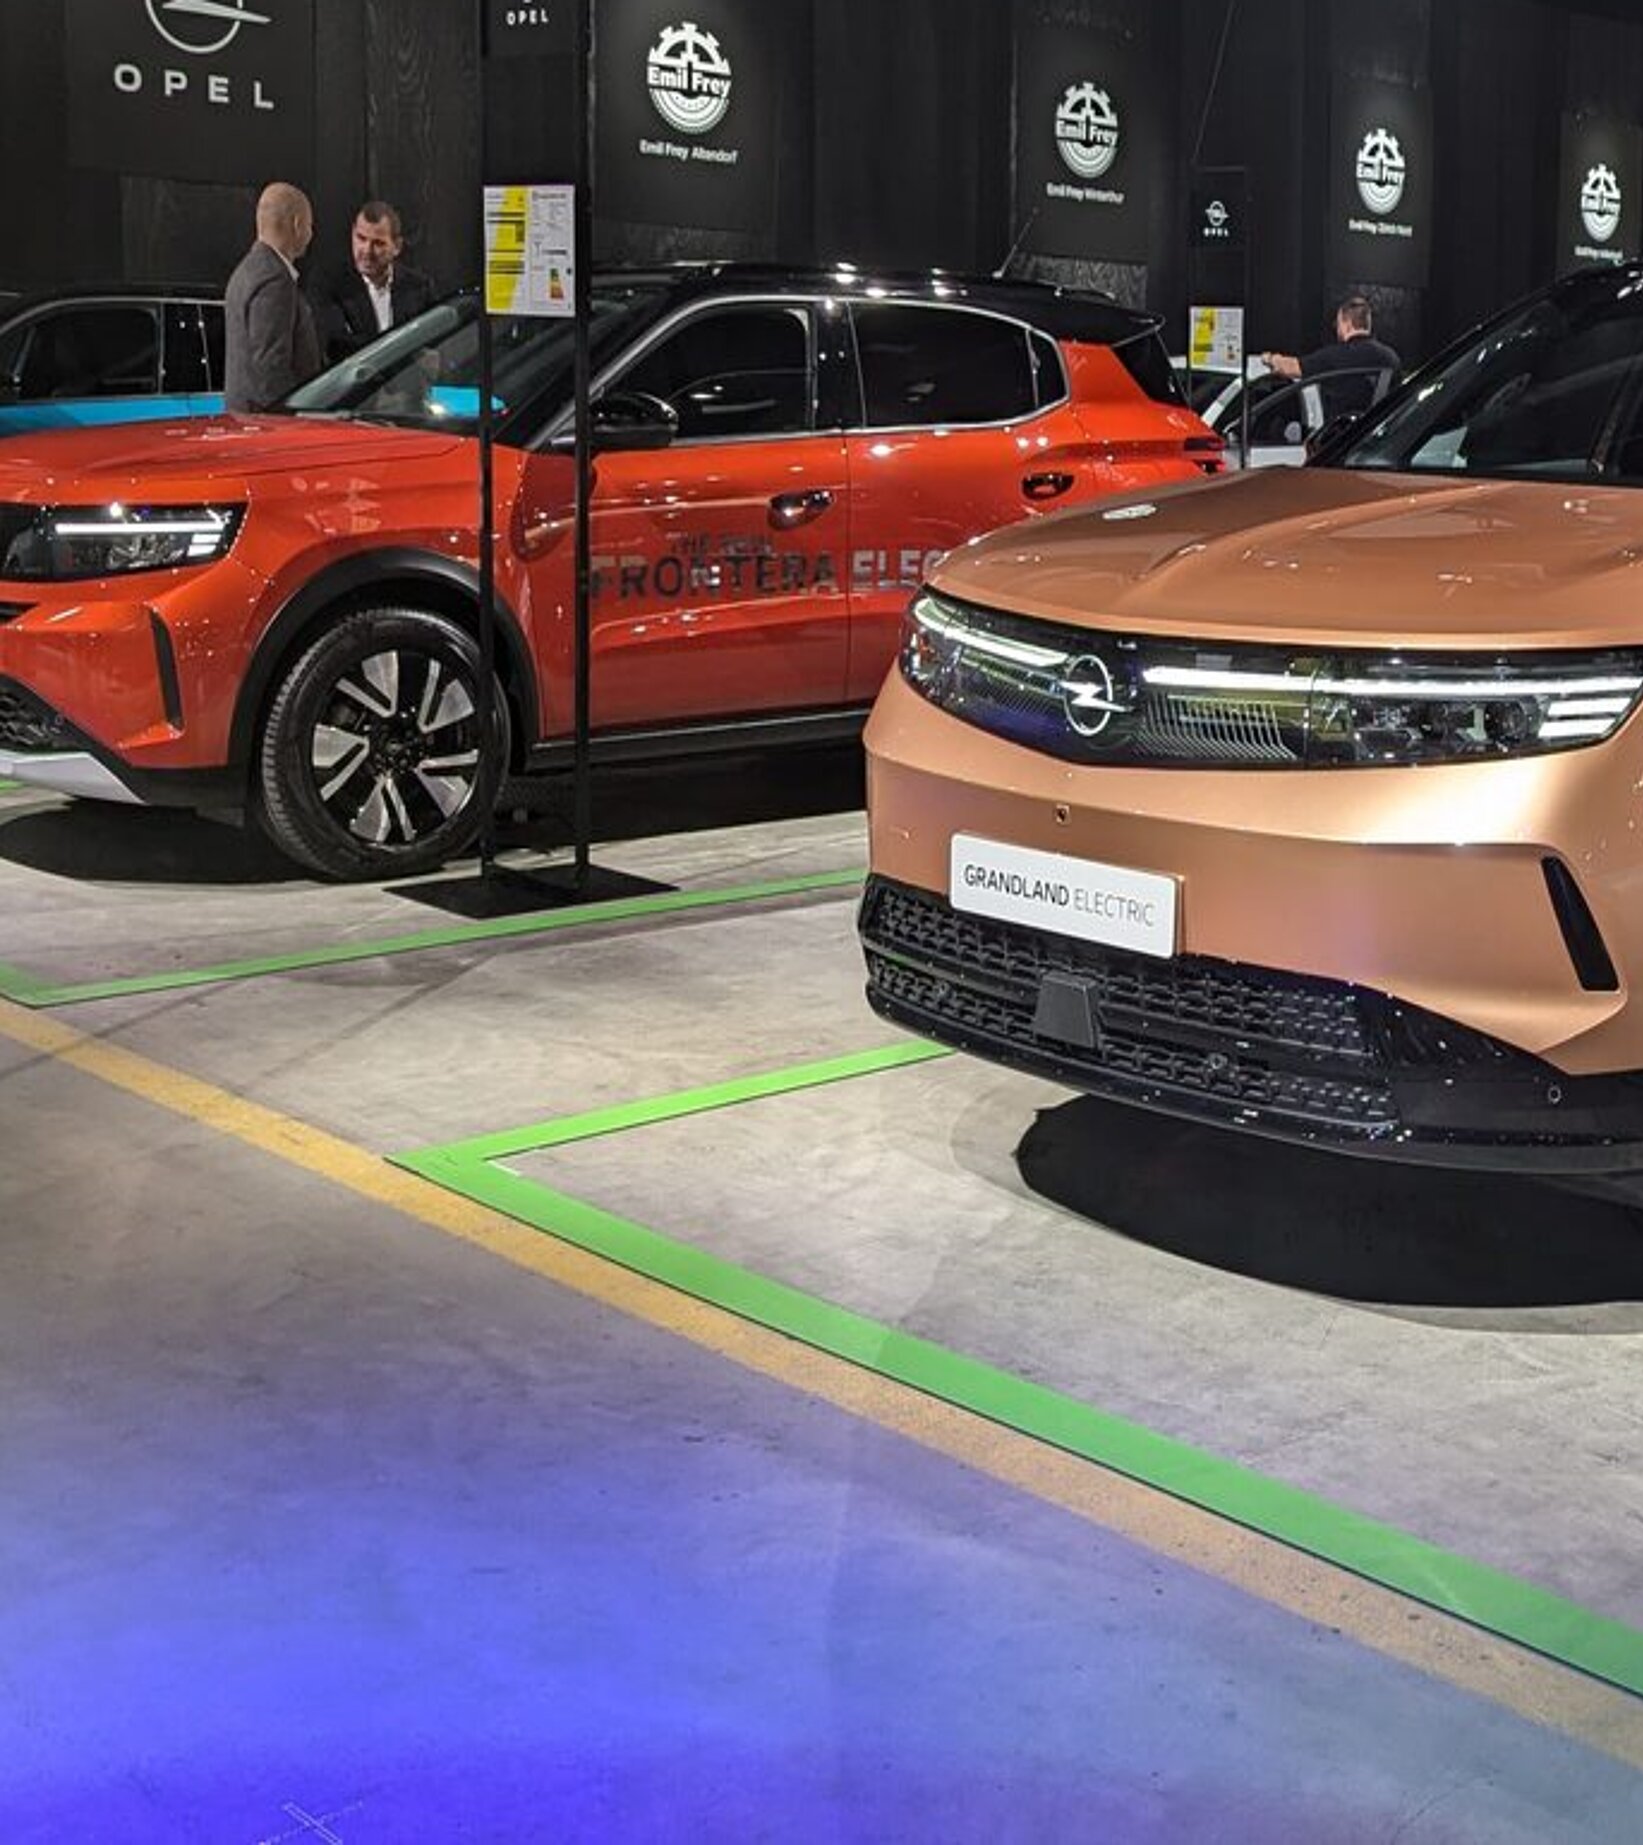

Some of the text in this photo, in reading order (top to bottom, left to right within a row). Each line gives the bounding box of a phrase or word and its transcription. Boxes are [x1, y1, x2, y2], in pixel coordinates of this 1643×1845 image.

[506, 8, 549, 26] OPEL
[114, 63, 274, 109] OPEL
[647, 65, 731, 98] Emil Frey
[1056, 120, 1118, 146] Emil Frey
[639, 138, 664, 154] Emil
[666, 142, 689, 161] Frey
[1357, 163, 1405, 187] Emil Frey
[590, 547, 948, 600] FRONTERA ELEC
[964, 864, 1156, 927] GRANDLAND ELECTRIC
